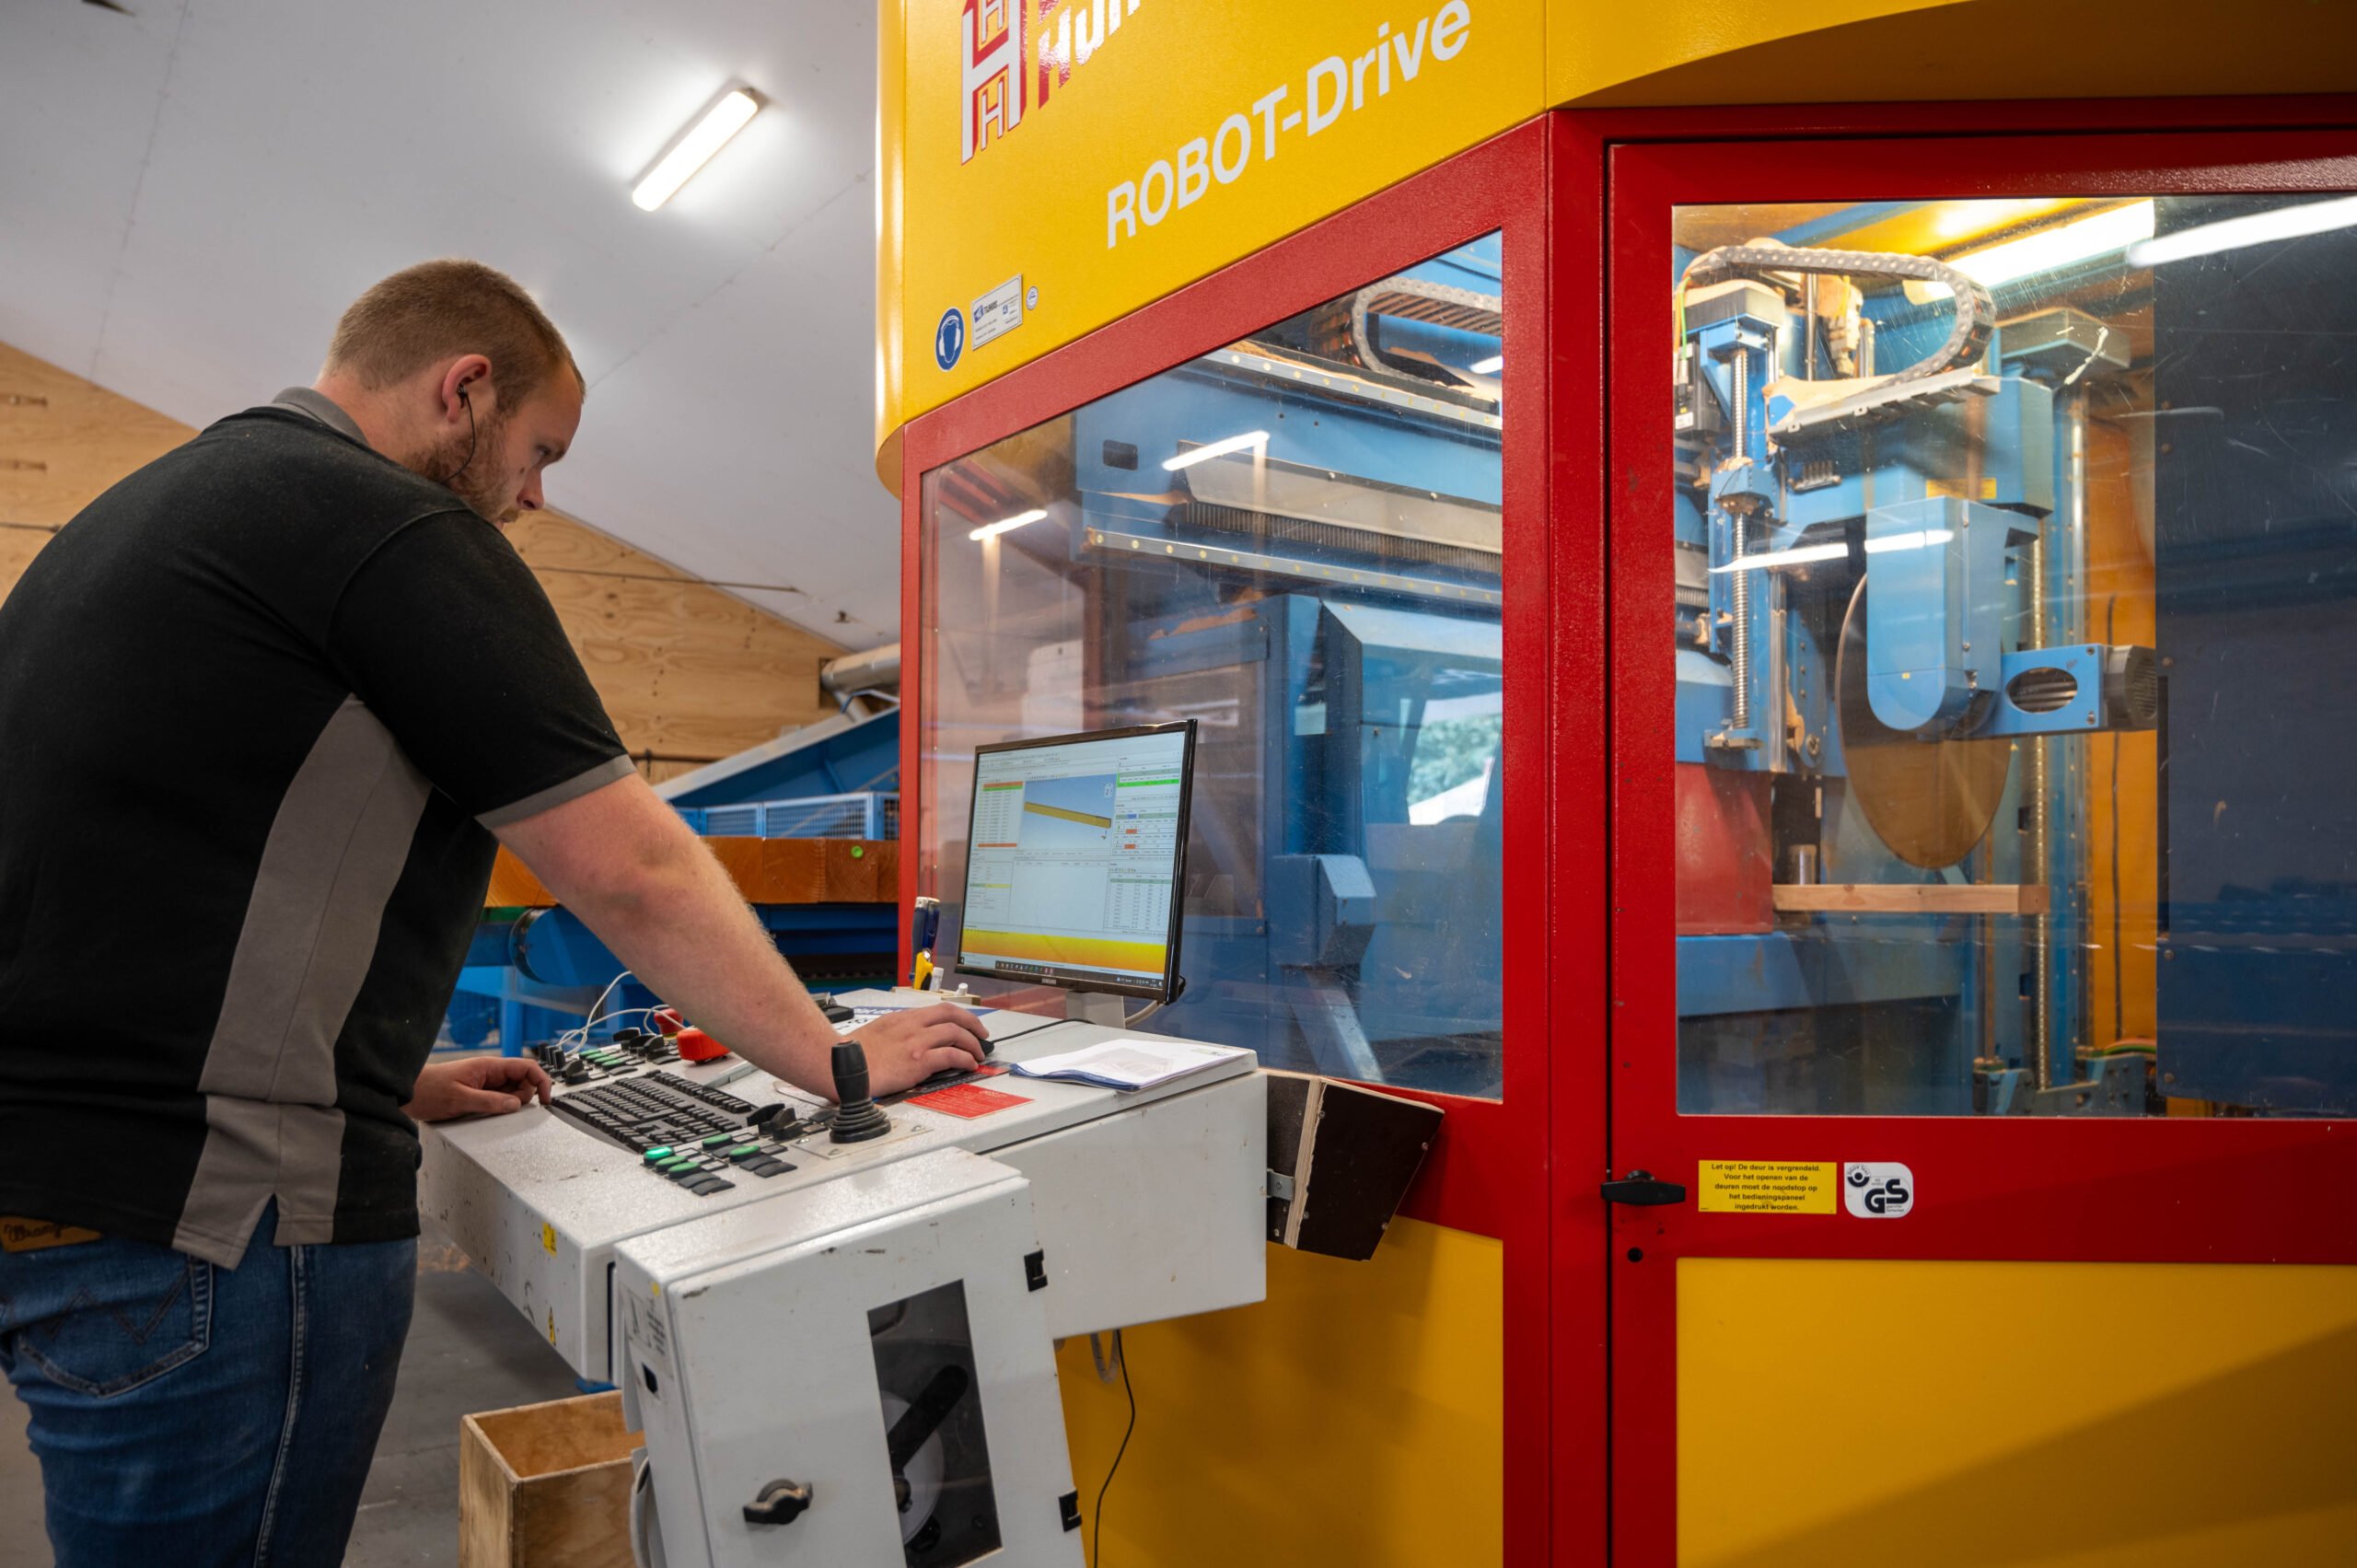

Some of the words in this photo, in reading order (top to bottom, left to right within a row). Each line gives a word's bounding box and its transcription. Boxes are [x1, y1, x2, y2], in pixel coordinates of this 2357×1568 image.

[1108, 0, 1471, 250] ROBOT-Drive
[1777, 1165, 1821, 1173] vergrendeld.
[1772, 1184, 1806, 1192] noodstop
[1742, 1193, 1805, 1202] bedieningspaneel
[1864, 1179, 1910, 1214] GS
[1735, 1202, 1769, 1211] ingedrukt
